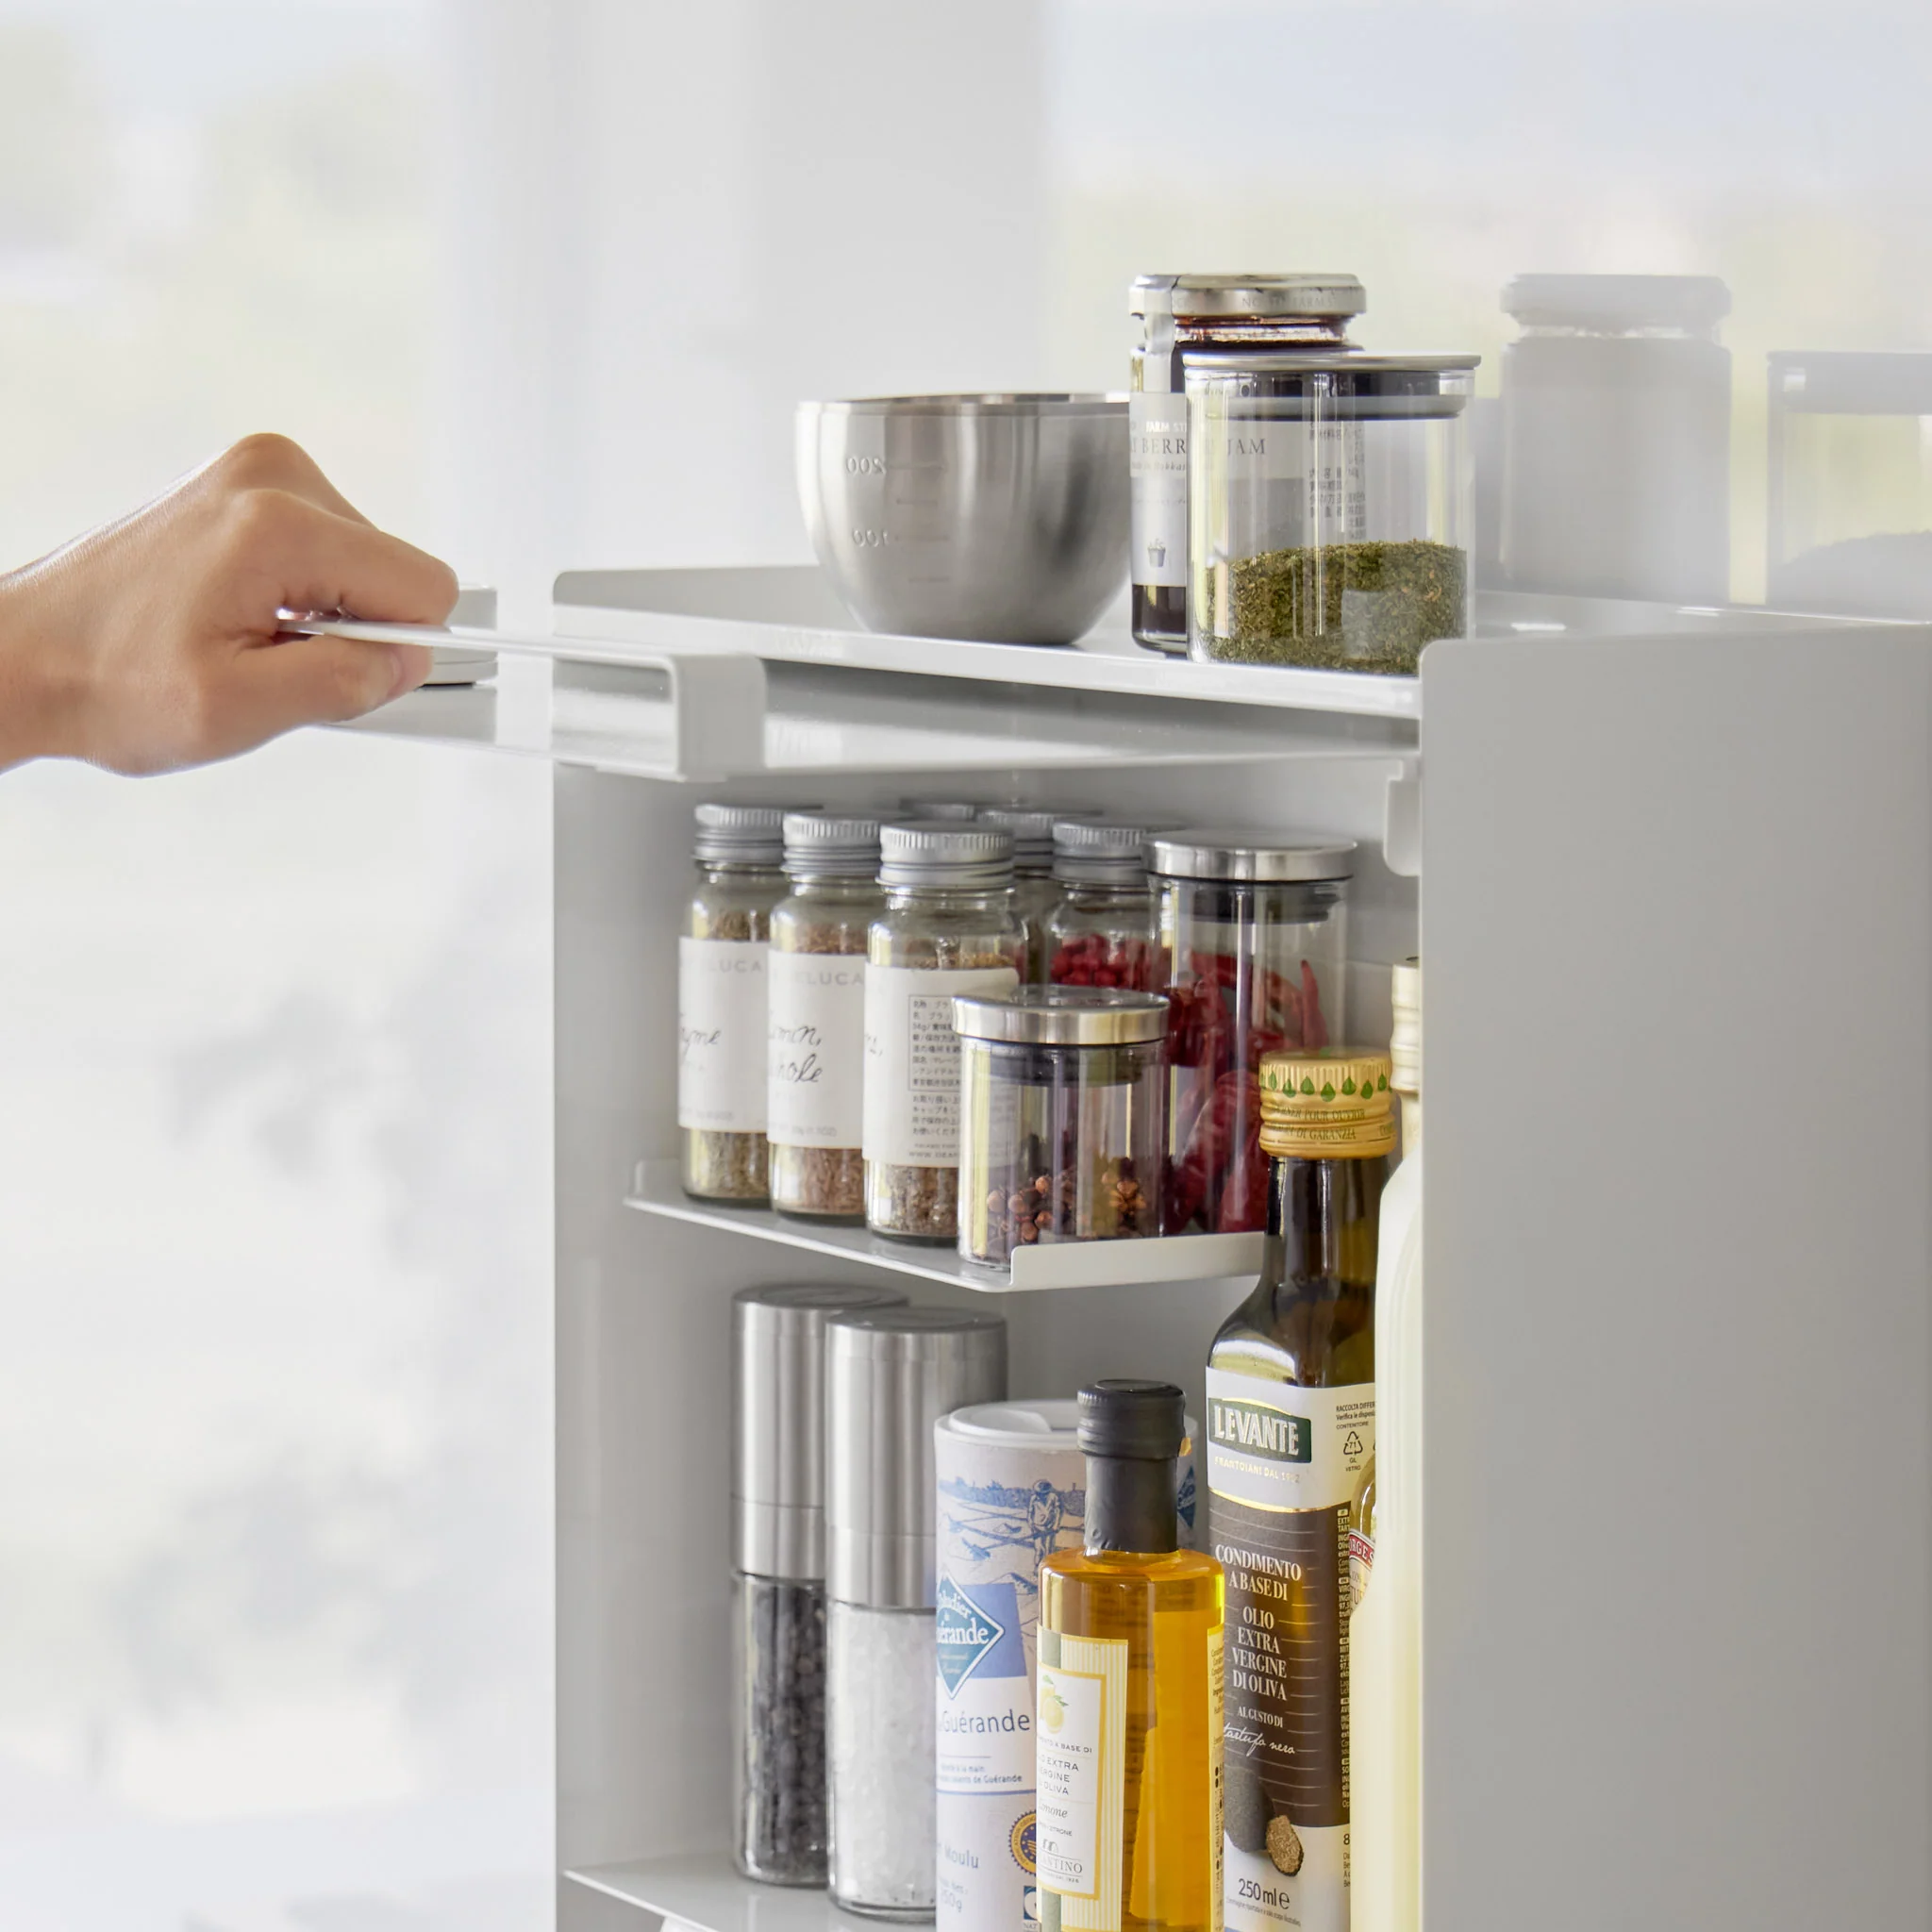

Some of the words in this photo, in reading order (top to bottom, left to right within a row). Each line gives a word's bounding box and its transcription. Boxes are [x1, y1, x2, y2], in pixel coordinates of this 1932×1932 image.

[1227, 438, 1266, 455] JAM
[1214, 1405, 1299, 1456] LEVANTE
[1264, 1467, 1278, 1479] DAL
[1215, 1543, 1302, 1581] CONDIMENTO
[1228, 1571, 1239, 1589] A
[1240, 1572, 1273, 1597] BASE
[1273, 1580, 1288, 1601] DI
[1242, 1606, 1274, 1629] OLIO
[1238, 1626, 1281, 1655] EXTRA
[1231, 1646, 1287, 1678] VERGINE
[1232, 1669, 1247, 1690] DI
[1248, 1674, 1288, 1701] OLIVA
[942, 1708, 1031, 1733] Guérande
[1238, 1706, 1248, 1718] AL
[1248, 1708, 1274, 1725] GUSTO
[1274, 1715, 1283, 1728] DI
[1061, 1743, 1081, 1753] BASE
[1040, 1766, 1070, 1783] ERGINE
[1047, 1757, 1079, 1772] EXTRA
[1043, 1781, 1069, 1795] OLIVA
[1239, 1878, 1260, 1901] 250
[1263, 1888, 1276, 1907] ml
